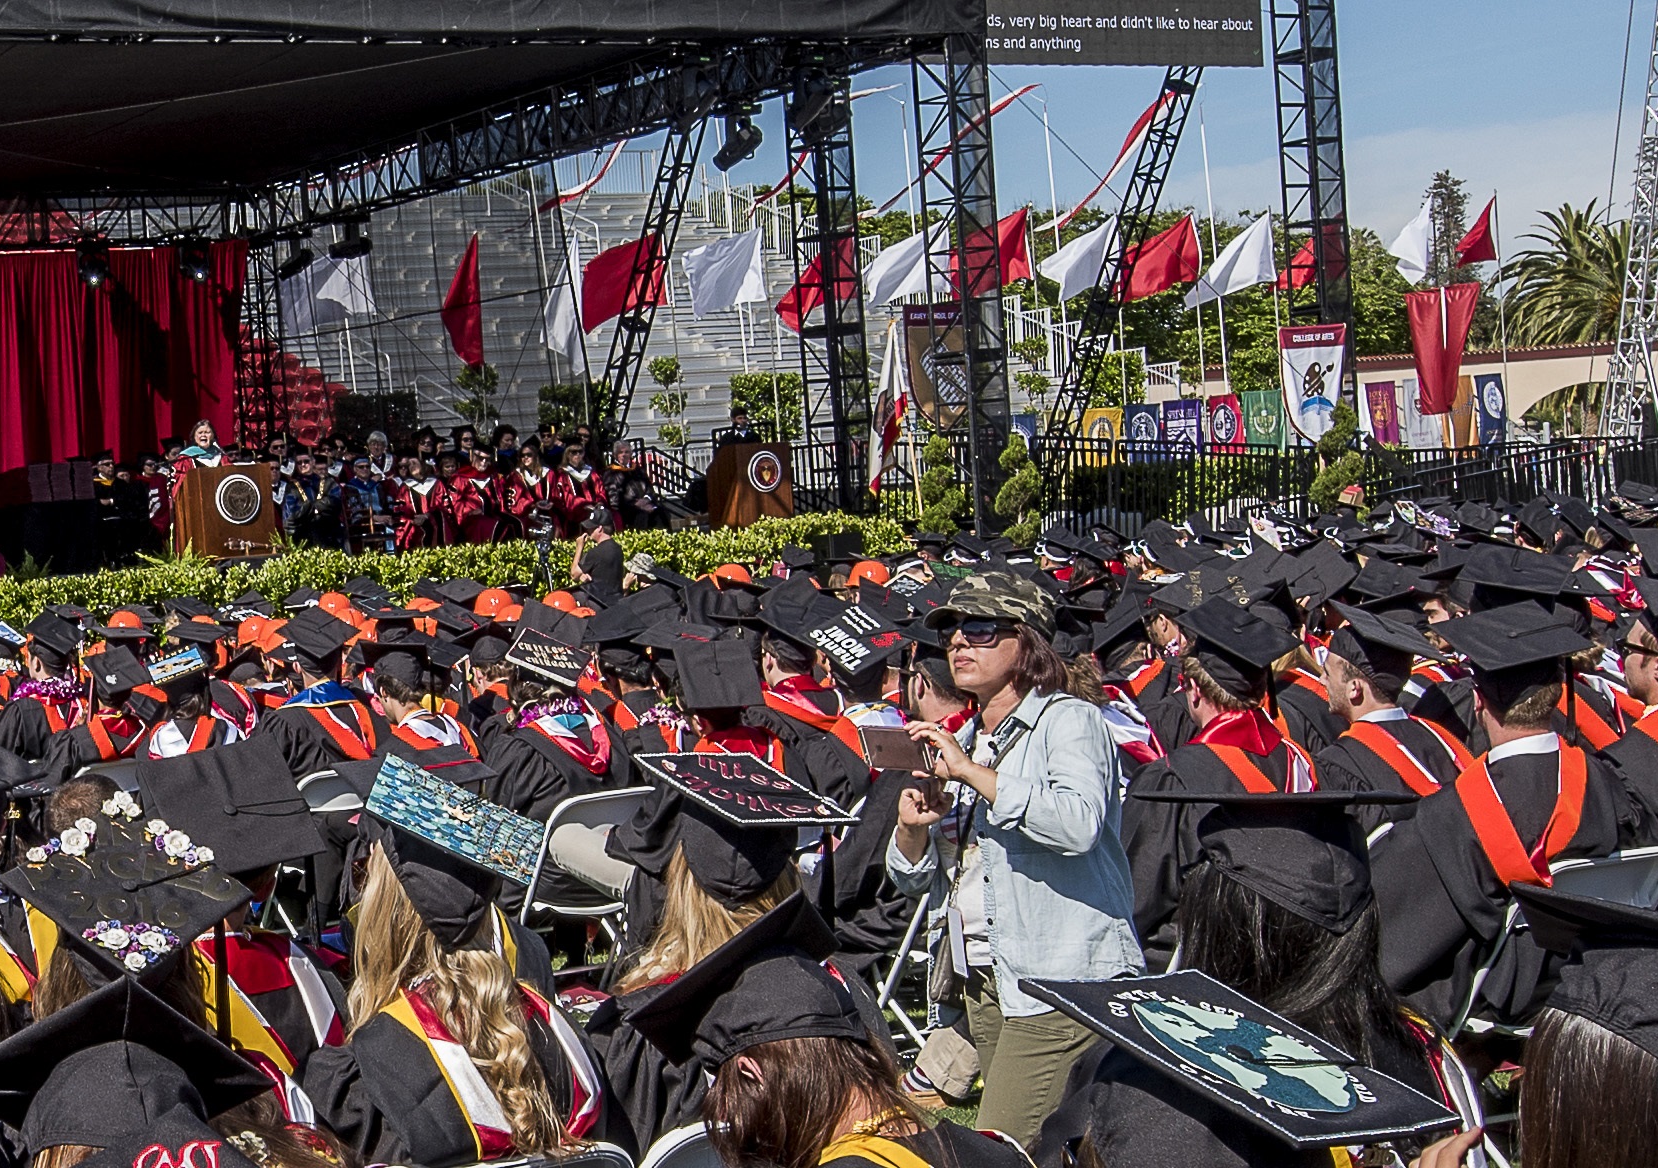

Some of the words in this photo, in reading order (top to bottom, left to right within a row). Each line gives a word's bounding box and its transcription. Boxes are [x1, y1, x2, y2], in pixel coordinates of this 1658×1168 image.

[1008, 16, 1036, 30] very
[1039, 14, 1057, 31] big
[1060, 15, 1093, 29] heart
[1095, 15, 1118, 30] and
[1120, 16, 1153, 30] didn't
[1155, 16, 1176, 30] like
[1177, 17, 1190, 30] to
[1193, 17, 1219, 30] hear
[1221, 18, 1254, 32] about
[1003, 35, 1026, 49] and
[1029, 36, 1082, 53] anything
[809, 629, 863, 671] Thanks
[823, 625, 871, 660] MOM!
[1107, 1001, 1129, 1018] GO
[1199, 1001, 1245, 1019] SET
